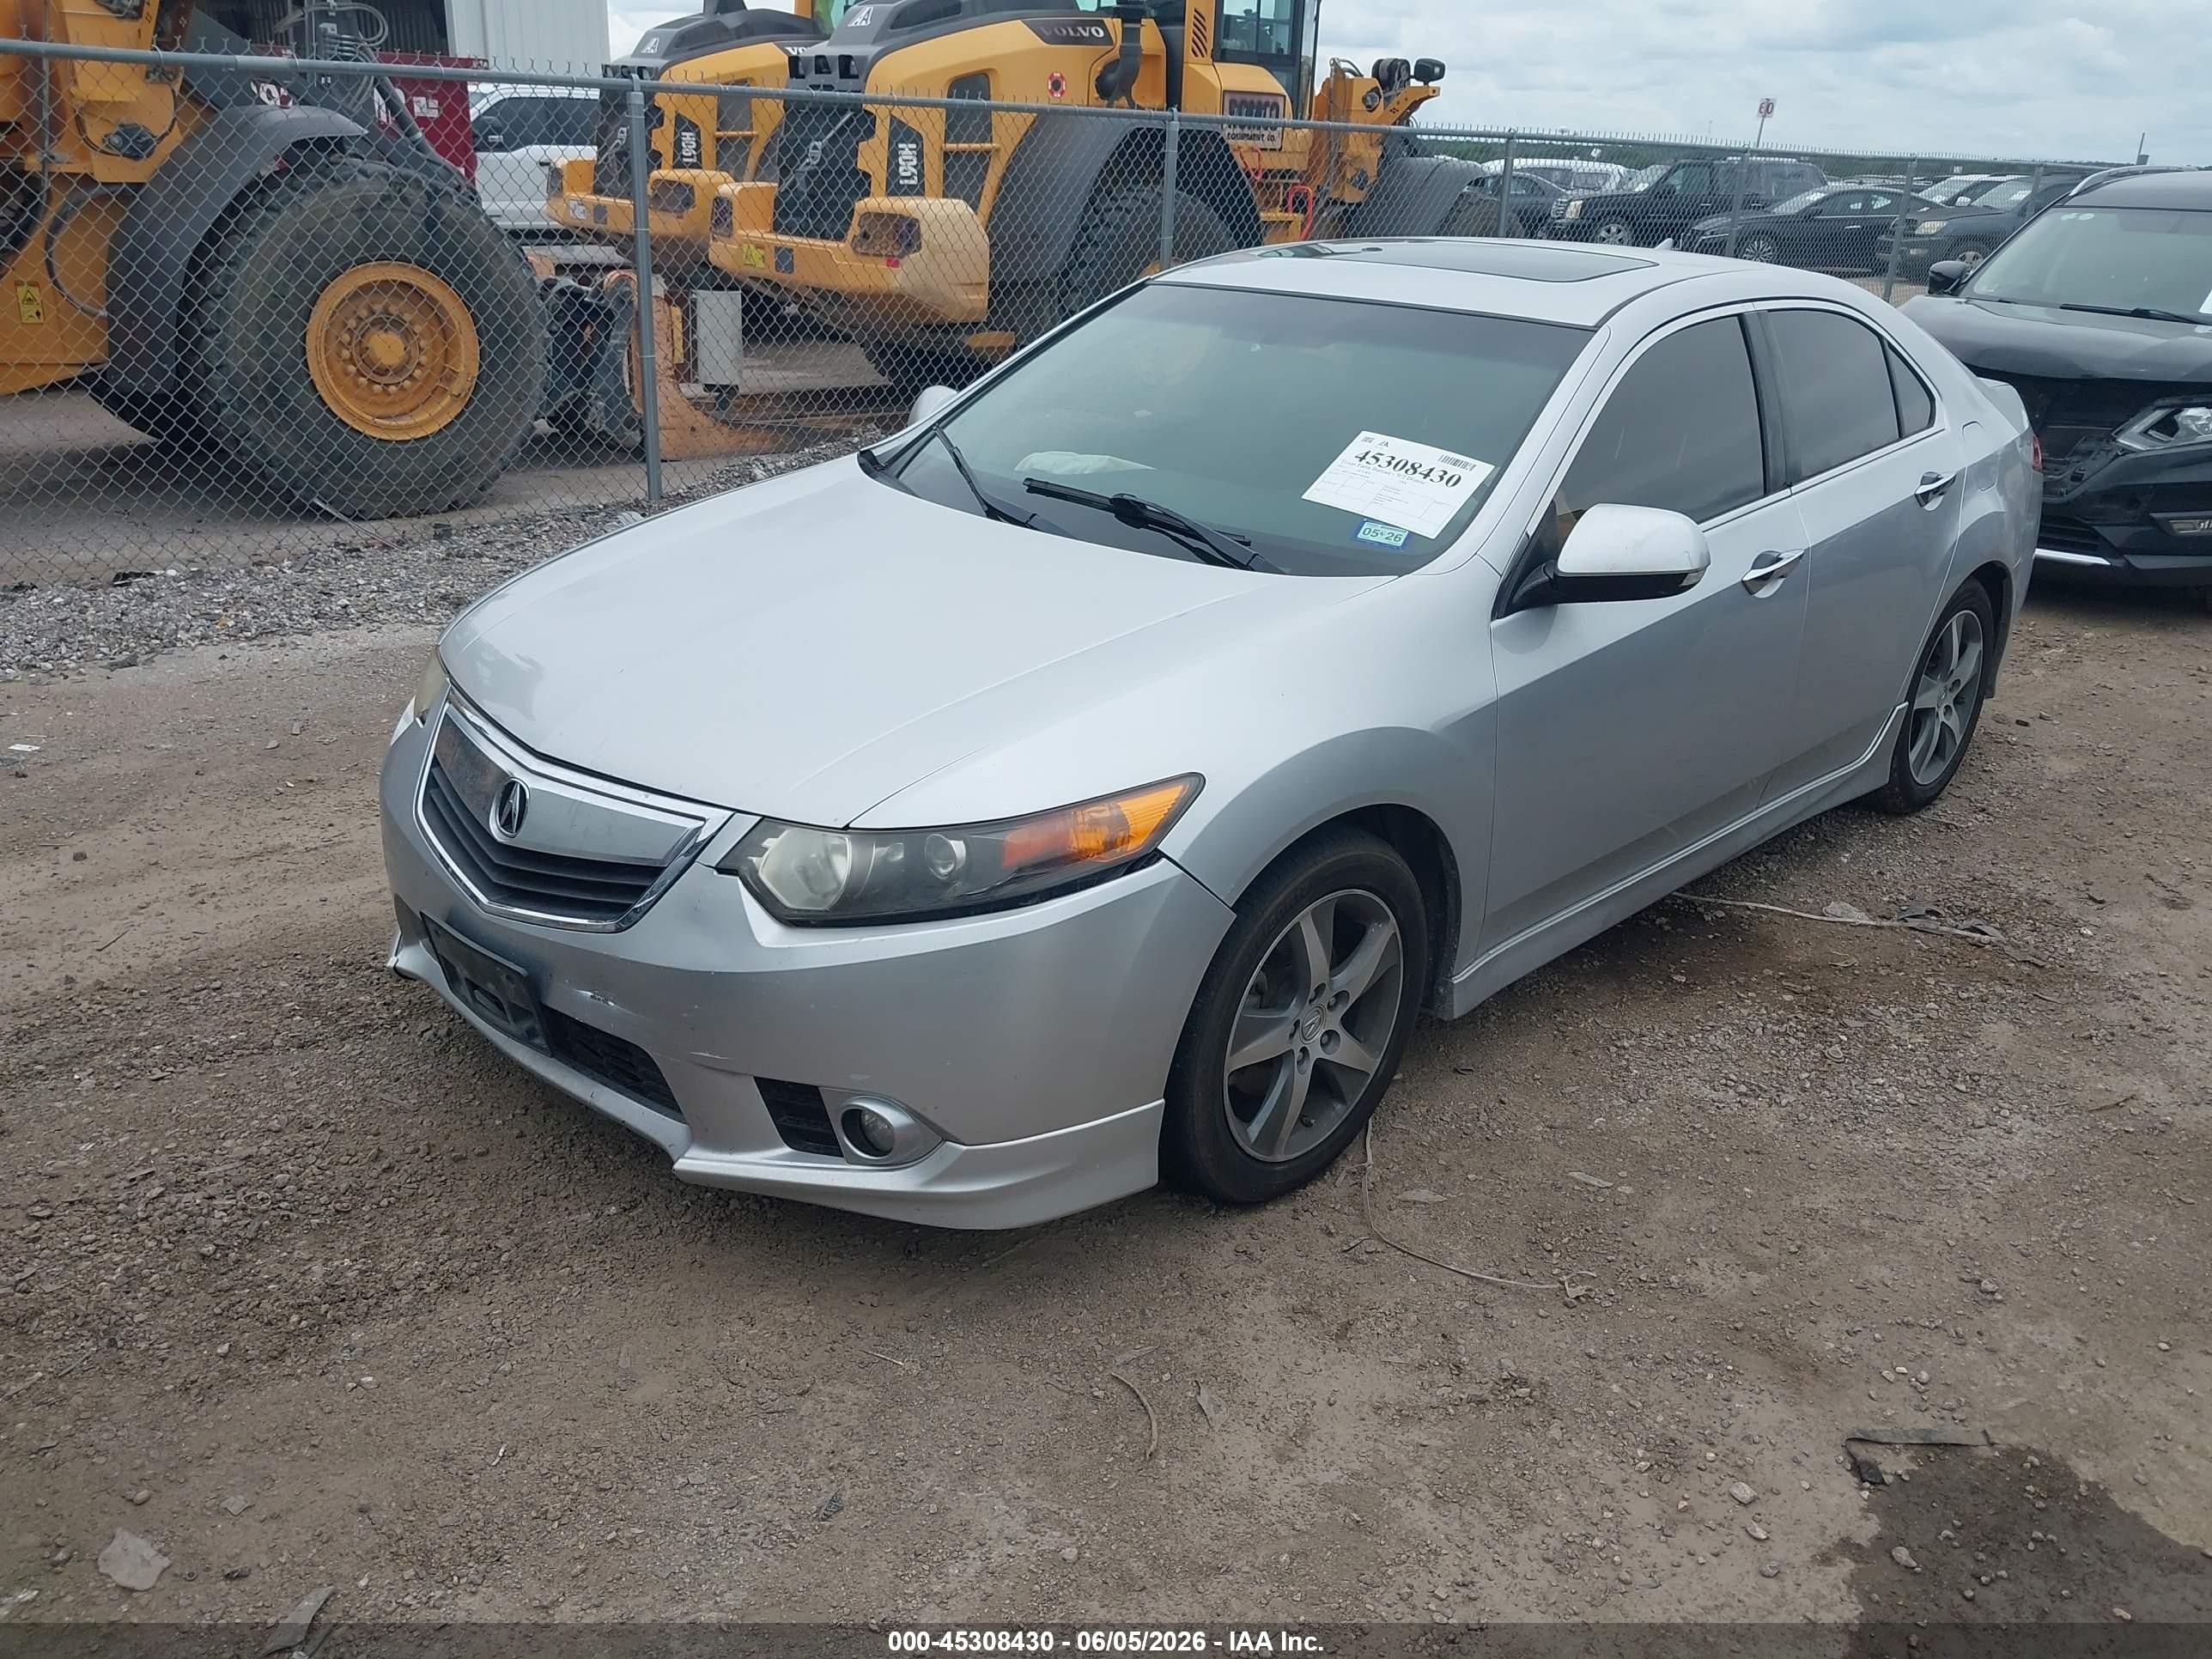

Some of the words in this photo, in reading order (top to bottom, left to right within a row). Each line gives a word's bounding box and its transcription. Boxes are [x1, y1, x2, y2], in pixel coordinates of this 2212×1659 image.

[1037, 26, 1105, 38] VOLVO
[680, 131, 697, 162] L90H
[897, 143, 918, 185] L90H
[1354, 450, 1462, 488] 45308430
